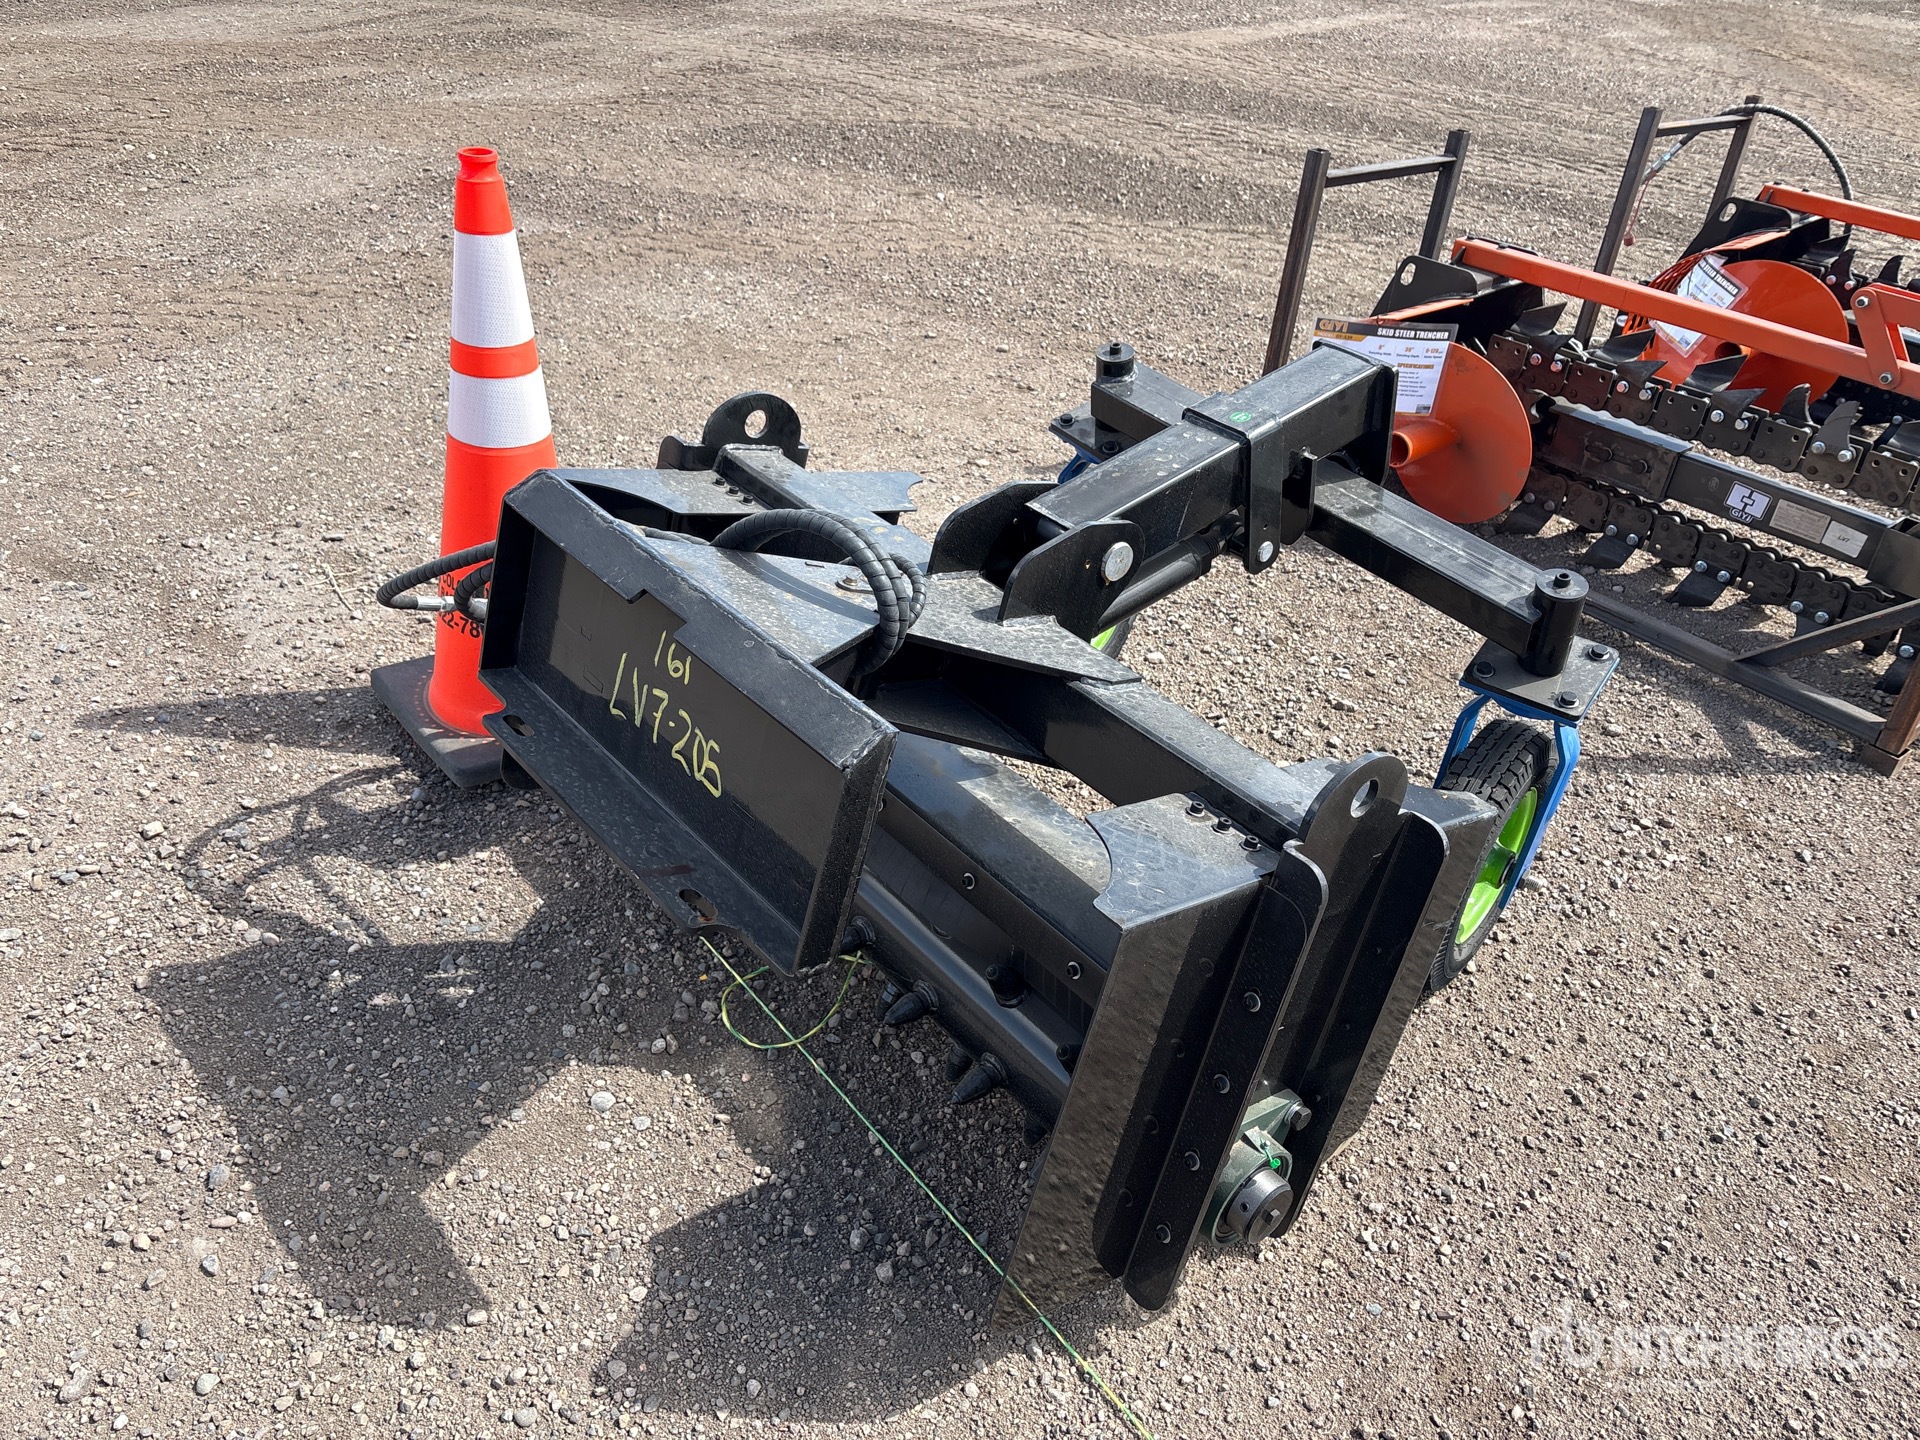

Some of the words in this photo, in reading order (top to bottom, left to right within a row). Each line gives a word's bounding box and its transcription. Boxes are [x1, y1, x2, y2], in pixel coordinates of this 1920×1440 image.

[1319, 319, 1348, 332] GIYI
[1377, 327, 1394, 337] SKID
[1395, 329, 1415, 338] STEER
[1416, 331, 1449, 340] TRENCHER
[1731, 509, 1751, 522] GIYI
[654, 630, 692, 685] 161
[610, 652, 722, 798] LV7-205
